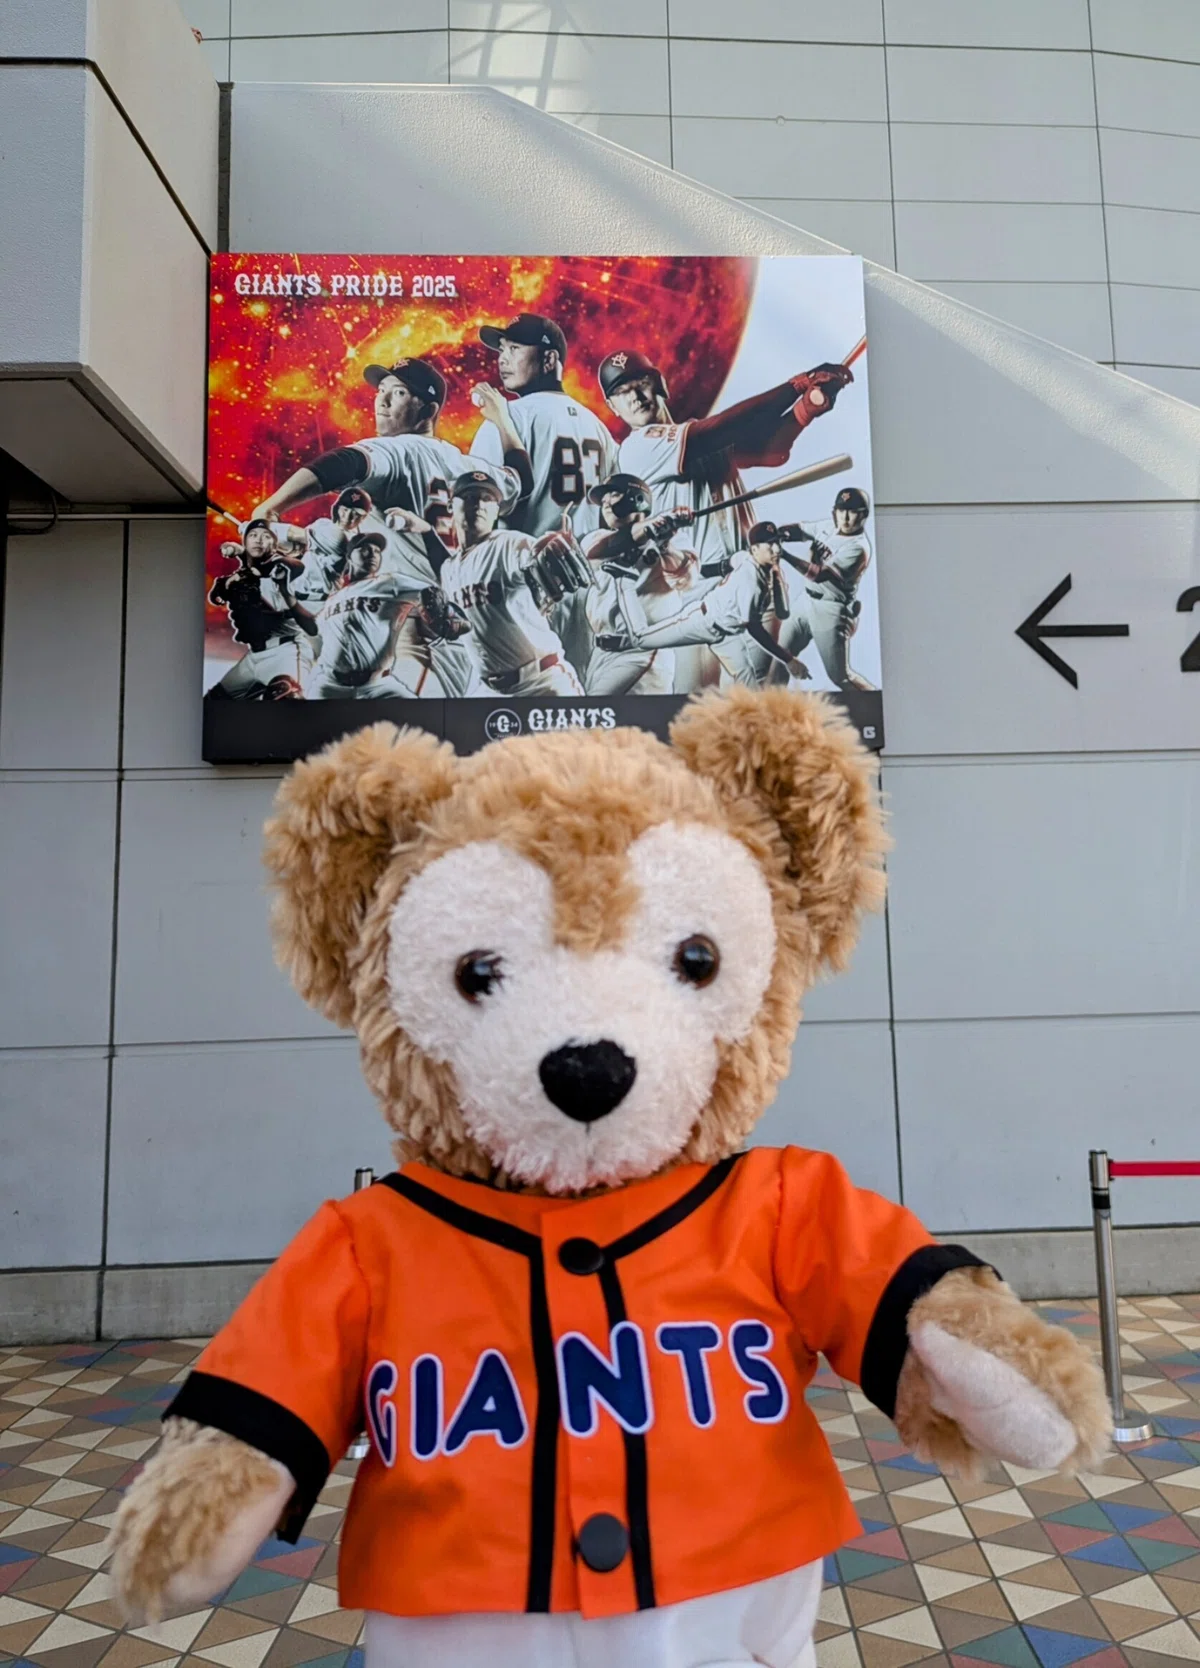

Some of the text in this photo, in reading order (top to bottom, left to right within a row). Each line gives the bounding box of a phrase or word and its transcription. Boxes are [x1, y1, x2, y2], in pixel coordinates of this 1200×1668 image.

[234, 273, 457, 298] GIANTS PRIDE 2025
[548, 436, 605, 507] 83
[528, 707, 616, 731] GIANTS
[365, 1318, 789, 1468] GIANTS
